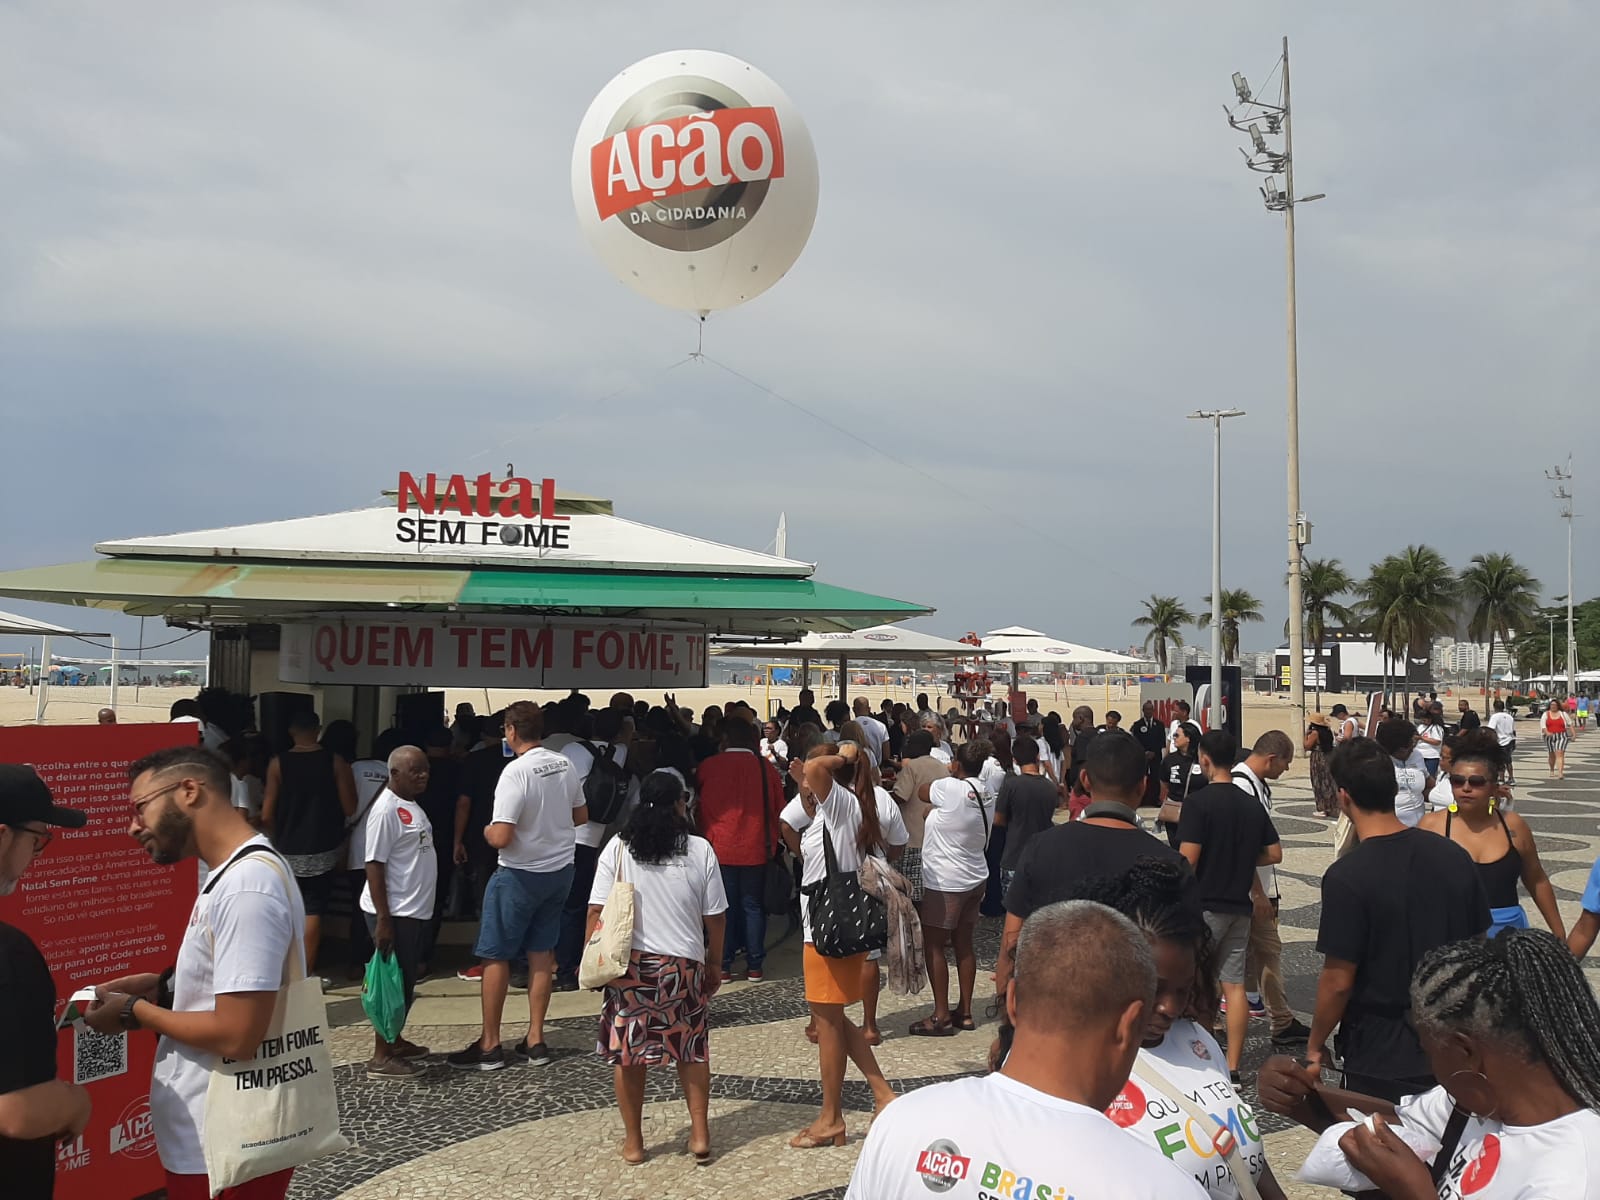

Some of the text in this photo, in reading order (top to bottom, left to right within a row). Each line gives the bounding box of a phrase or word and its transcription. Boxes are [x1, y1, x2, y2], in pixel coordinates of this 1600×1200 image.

[630, 206, 747, 224] DA CIDADANIA
[396, 518, 466, 544] SEM
[314, 625, 434, 672] QUEM
[448, 628, 553, 668] TEM
[573, 630, 680, 676] FOME,
[74, 760, 99, 769] entre
[110, 760, 128, 770] que
[56, 772, 87, 781] deixar
[64, 786, 86, 794] para
[70, 797, 86, 805] por
[62, 830, 89, 839] todas
[34, 858, 55, 868] para
[56, 854, 73, 863] isso
[76, 854, 94, 862] que
[92, 862, 103, 871] da
[22, 881, 48, 891] Natal
[50, 878, 71, 887] Sem
[72, 875, 98, 885] Fome
[101, 872, 131, 881] chama
[79, 942, 110, 956] aponte
[65, 960, 85, 970] para
[111, 950, 133, 960] Code
[70, 968, 102, 980] quanto
[286, 1026, 324, 1052] FOME,
[234, 1056, 318, 1091] TEM PRESSA.
